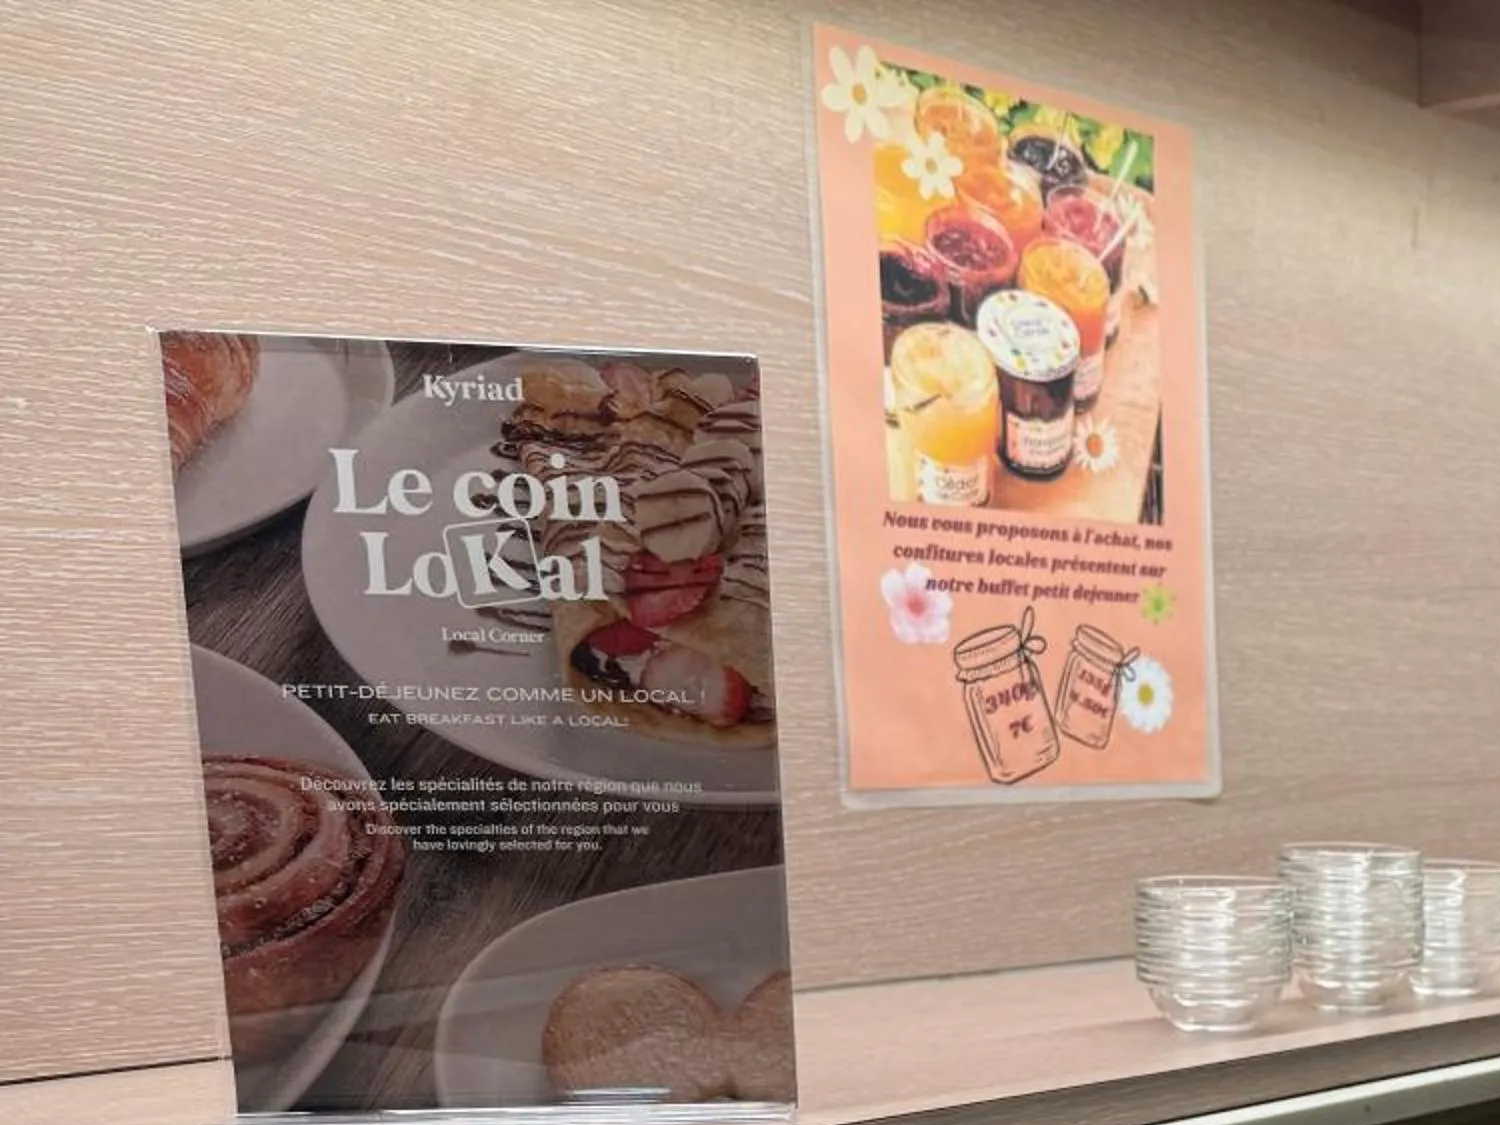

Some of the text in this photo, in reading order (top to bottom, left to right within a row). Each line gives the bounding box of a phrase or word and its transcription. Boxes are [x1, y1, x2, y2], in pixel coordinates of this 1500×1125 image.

[423, 374, 525, 406] Kyriad
[328, 448, 628, 522] Le coin
[882, 511, 929, 531] Nous
[931, 518, 973, 534] vous
[975, 522, 1069, 542] proposons
[1072, 528, 1082, 543] à
[1145, 538, 1173, 551] nos
[360, 530, 609, 601] LoKal
[893, 543, 1168, 578] confitures locales présentent sur
[925, 577, 1140, 606] notre buffet petit dejeuner
[441, 627, 545, 643] Local Corner
[281, 681, 480, 701] PETIT-DÉJEUNEZ
[486, 686, 576, 702] COMME
[580, 688, 615, 703] UN
[619, 688, 695, 704] LOCAL
[368, 712, 400, 725] EAT
[405, 713, 505, 726] BREAKFAST
[511, 715, 545, 726] LIKE
[552, 716, 564, 726] A
[300, 775, 701, 795] Découvrez les spécialités de notre région que nous
[327, 797, 681, 815] avons spécialement sélectionnées pour vous
[365, 823, 650, 837] Discover the specialties of the region that we
[413, 839, 444, 851] have
[447, 839, 496, 853] lovingly
[499, 840, 553, 851] selected
[555, 840, 574, 851] for
